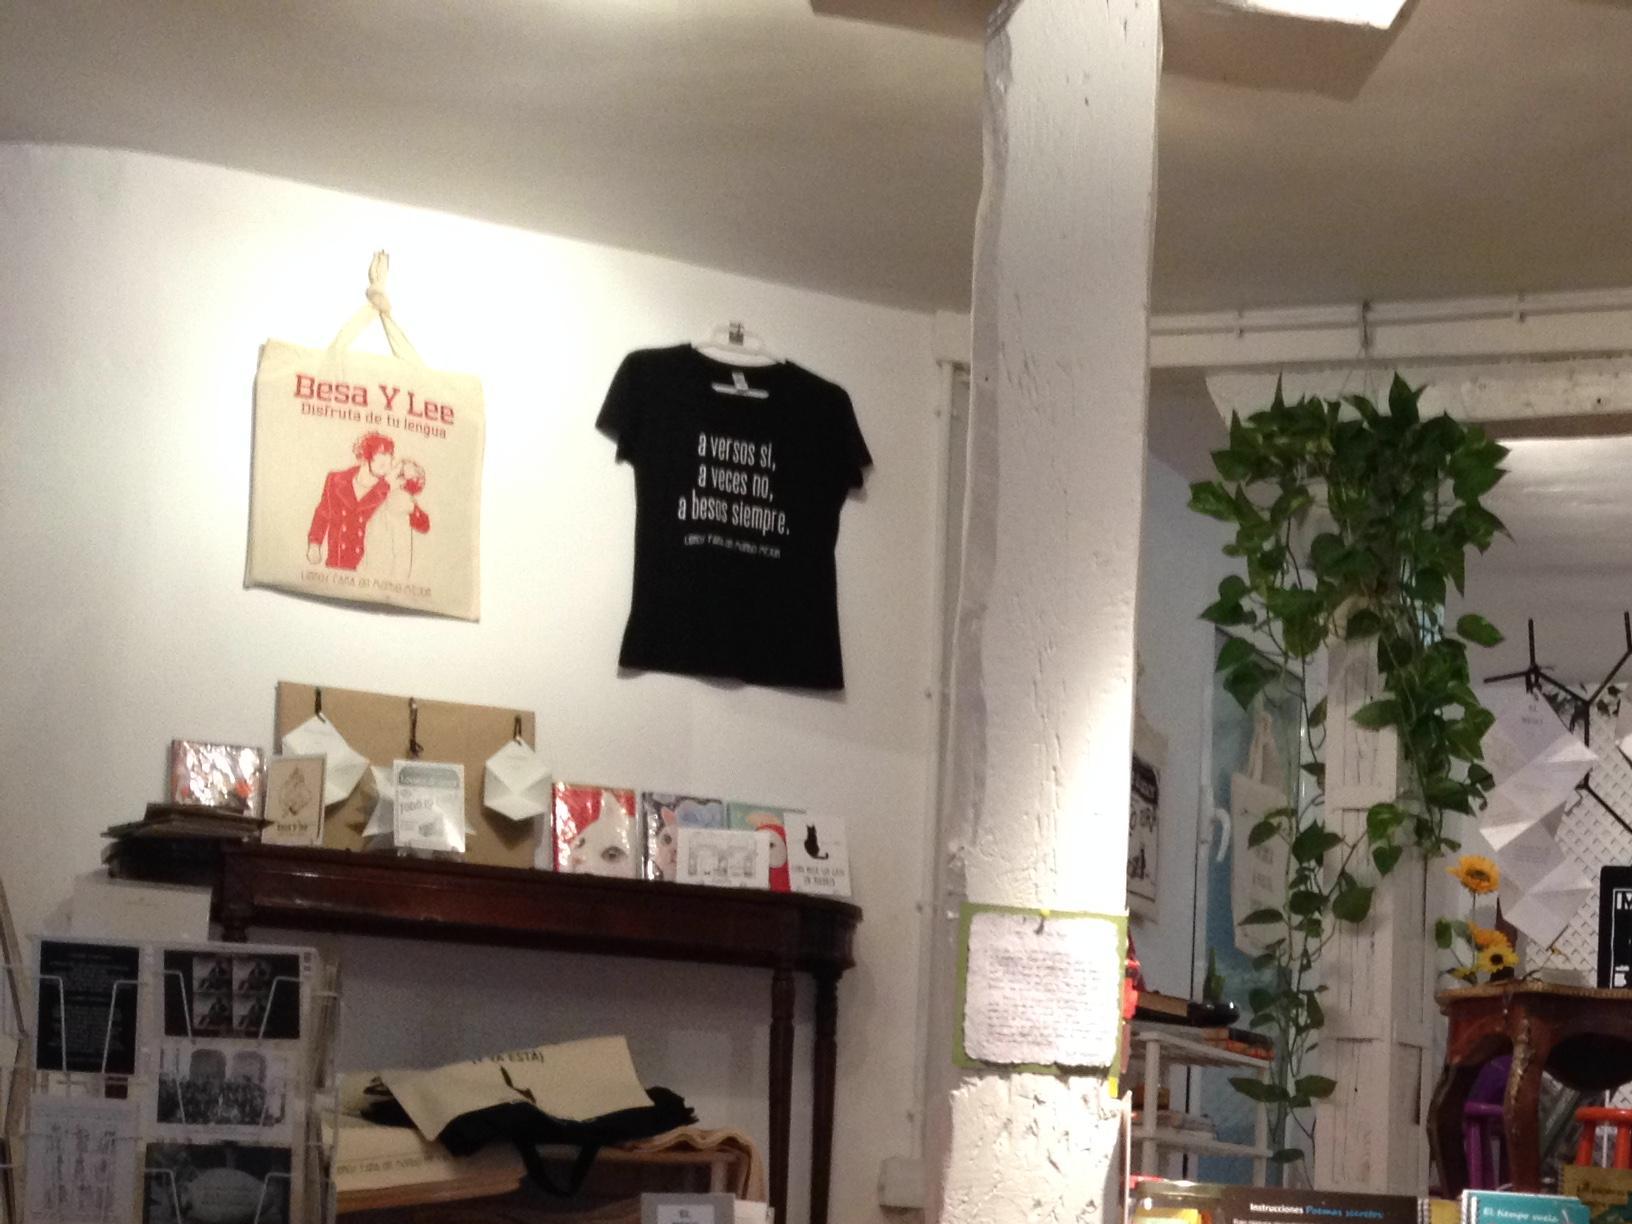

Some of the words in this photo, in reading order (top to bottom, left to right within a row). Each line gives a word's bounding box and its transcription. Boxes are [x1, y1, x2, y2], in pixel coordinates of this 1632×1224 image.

[293, 373, 369, 407] Besa
[378, 383, 400, 411] Y
[407, 390, 455, 425] Lee
[300, 402, 361, 422] Disfruta
[365, 411, 382, 425] de
[387, 414, 400, 428] tu
[404, 418, 446, 439] lengua
[698, 431, 707, 457] a
[710, 435, 755, 466] versos
[698, 463, 707, 488] a
[711, 465, 748, 495] veces
[752, 474, 773, 502] no,
[678, 495, 686, 520] a
[692, 488, 728, 523] besos
[732, 500, 790, 536] siempre.
[1250, 1203, 1303, 1214] Instrucciones
